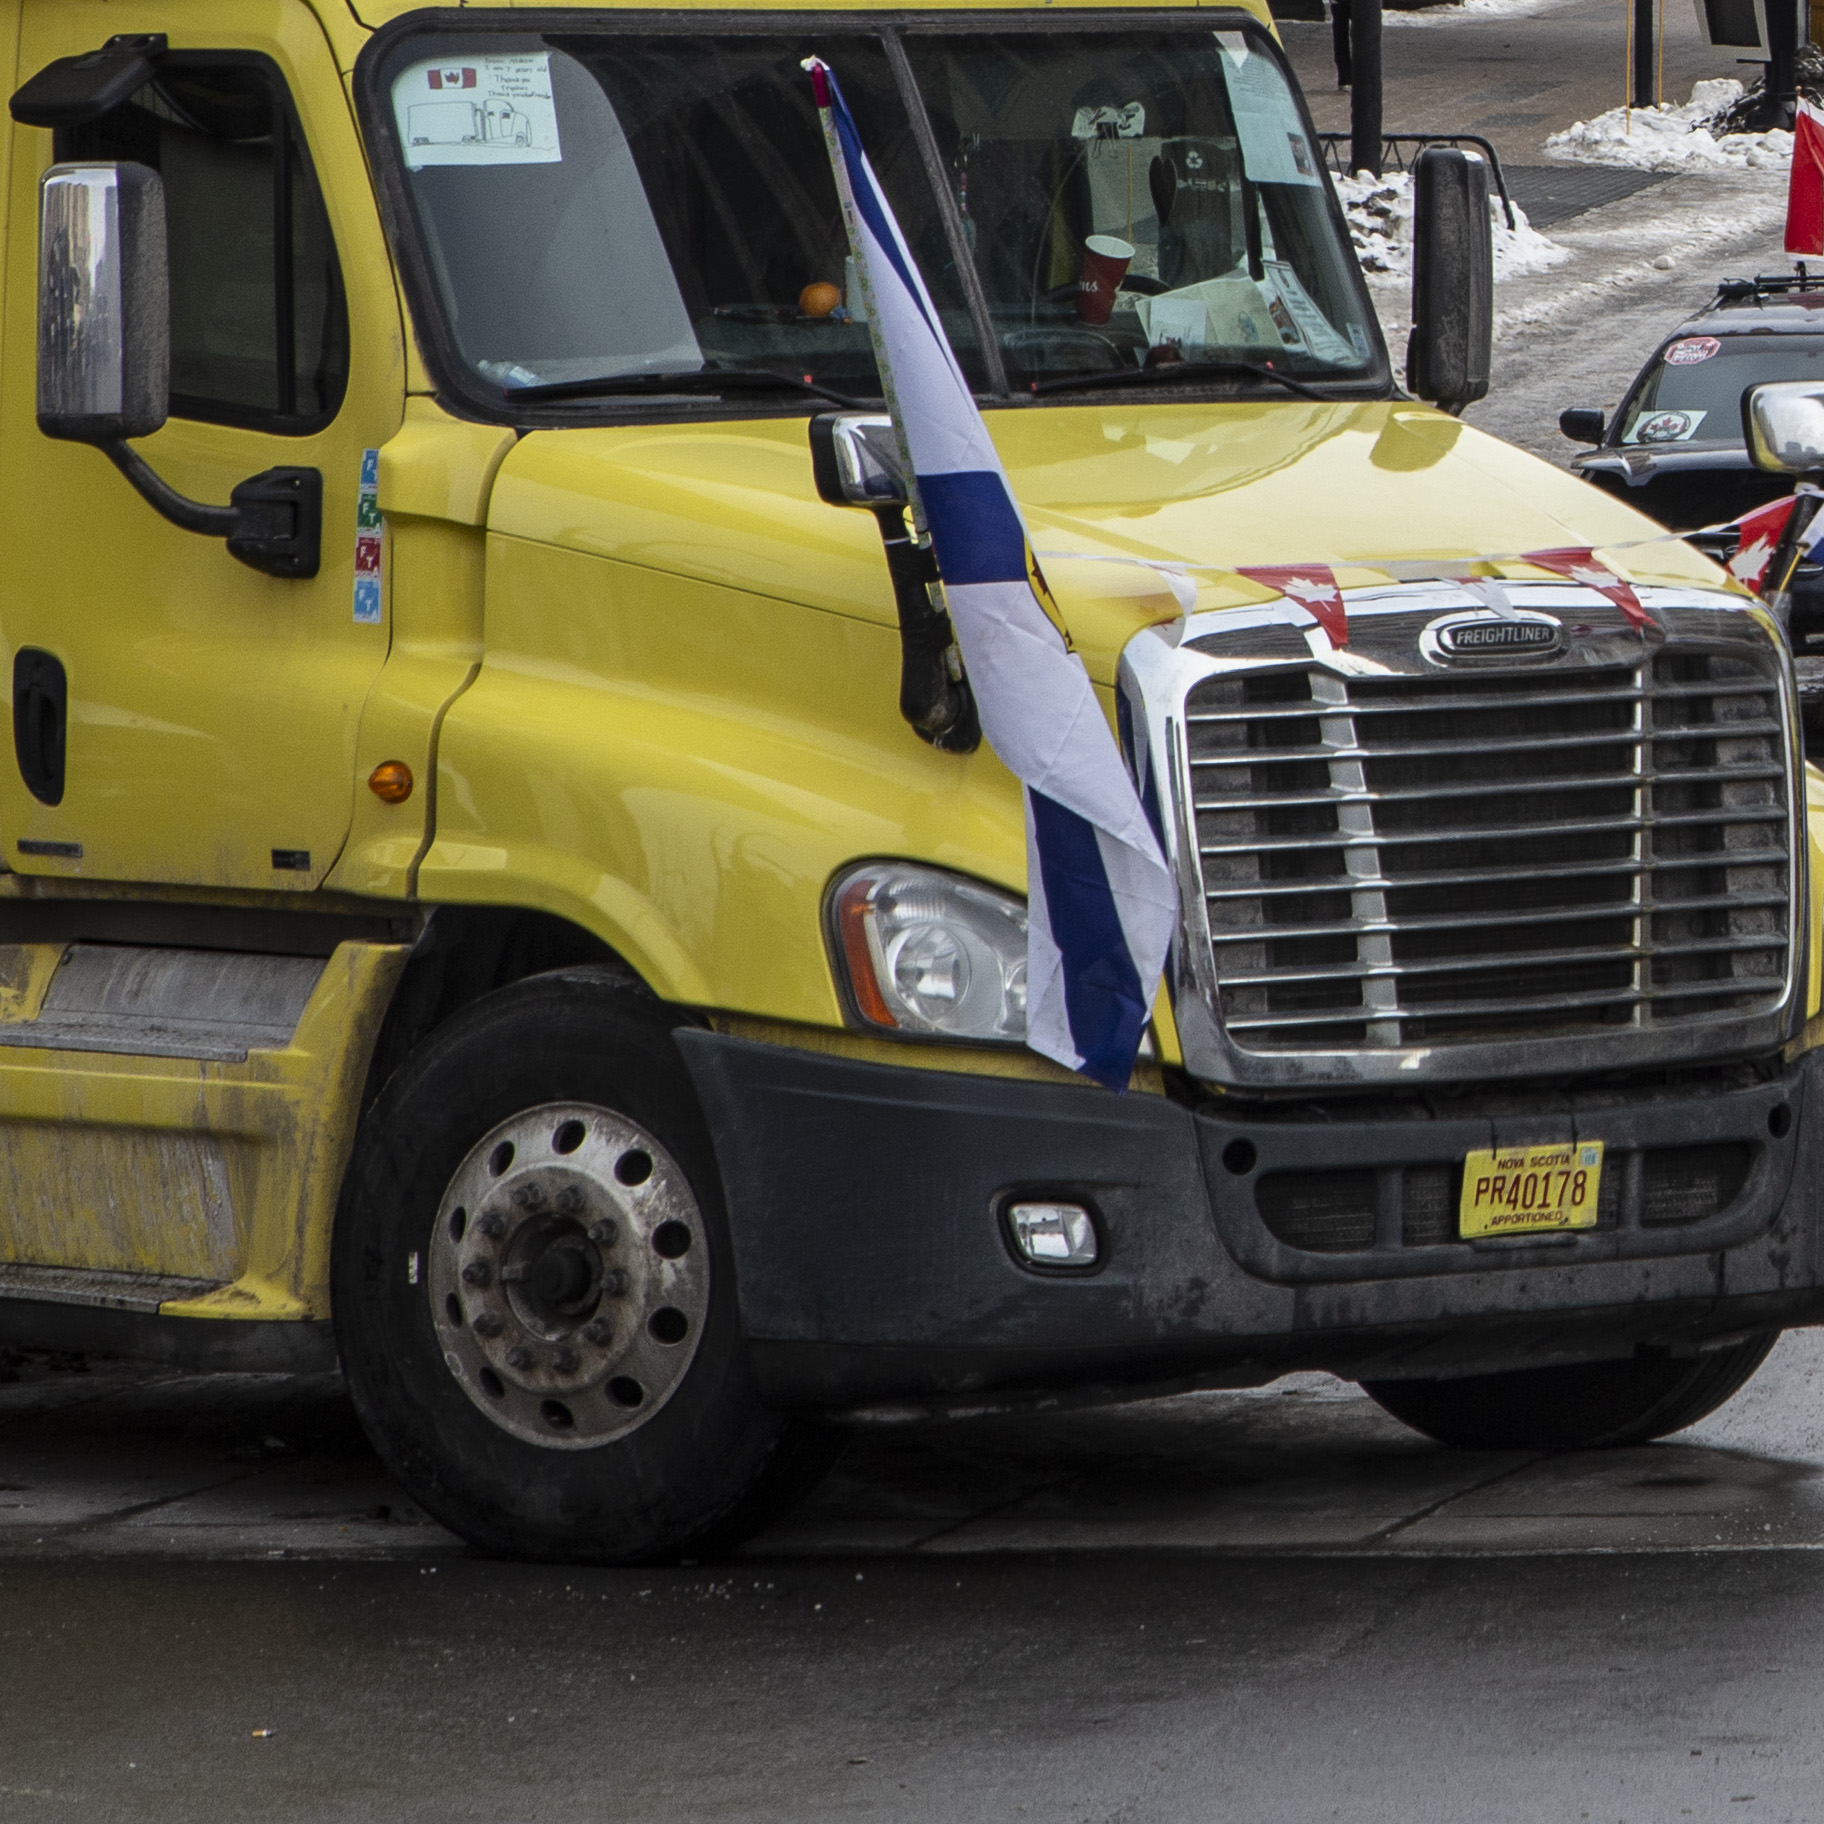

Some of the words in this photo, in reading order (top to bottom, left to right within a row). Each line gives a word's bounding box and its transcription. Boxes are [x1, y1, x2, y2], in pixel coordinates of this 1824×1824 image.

[1455, 624, 1552, 646] FREIGHTLINER
[1497, 1156, 1526, 1172] NOVA
[1529, 1154, 1571, 1170] SCOTIA
[1474, 1169, 1587, 1210] PR40178
[1491, 1209, 1564, 1227] APPORTIONED
